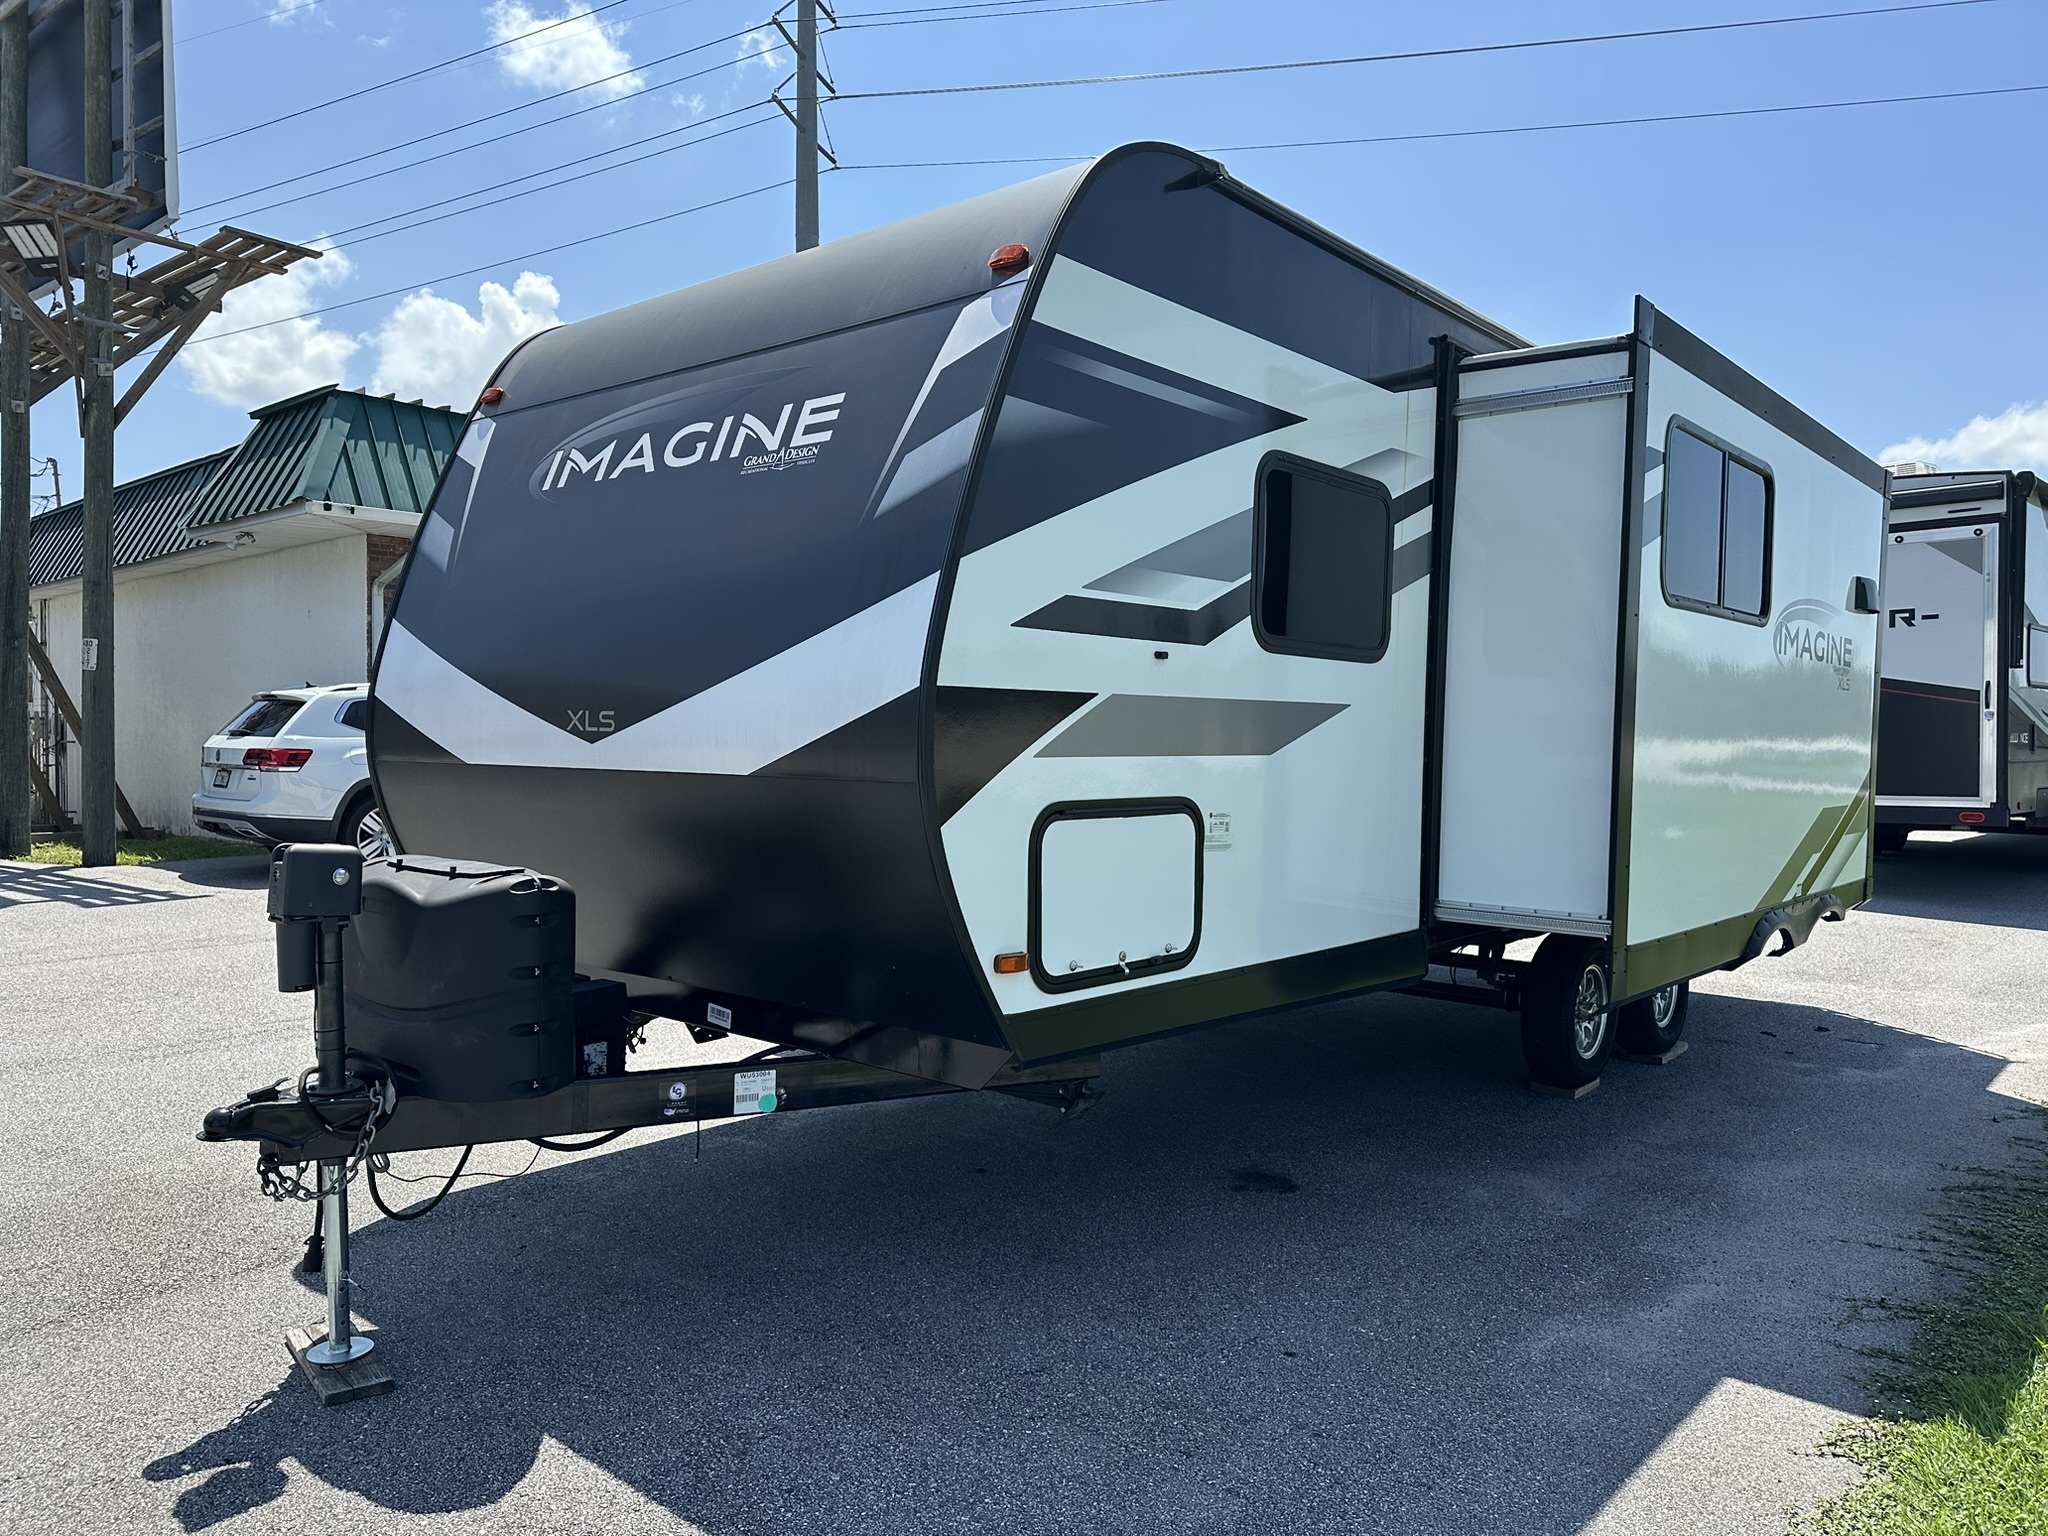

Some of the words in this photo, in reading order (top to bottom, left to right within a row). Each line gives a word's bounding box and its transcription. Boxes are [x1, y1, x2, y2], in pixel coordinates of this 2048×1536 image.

[542, 392, 847, 491] IMAGINE
[743, 452, 777, 467] GRAND
[784, 445, 821, 460] DESIGN
[1778, 620, 1853, 668] IMAGINE
[1837, 676, 1851, 692] XLS
[566, 709, 616, 732] XLS
